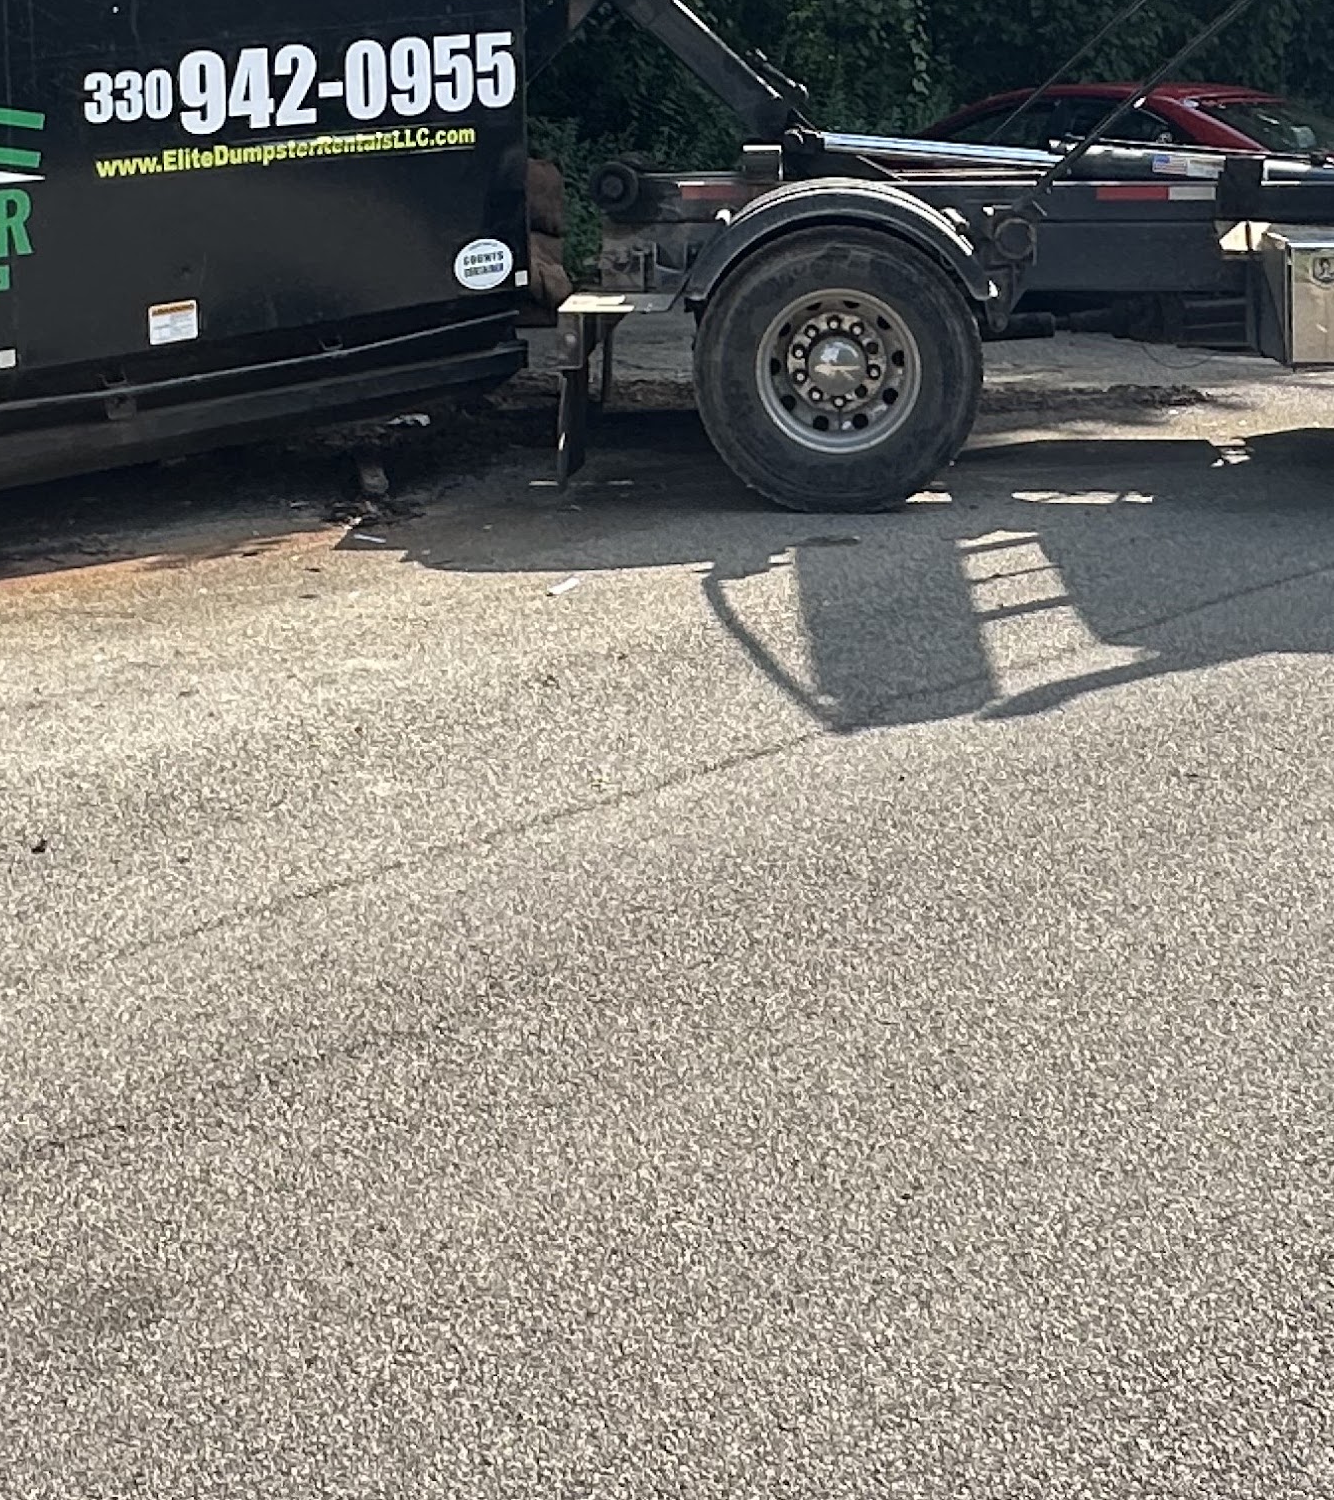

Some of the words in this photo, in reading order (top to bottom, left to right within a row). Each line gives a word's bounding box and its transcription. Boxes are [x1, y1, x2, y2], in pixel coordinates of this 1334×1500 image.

[83, 69, 173, 123] 330
[178, 32, 516, 134] 942-0955
[95, 127, 476, 178] www.EliteDumpsterRentalsLLC.com
